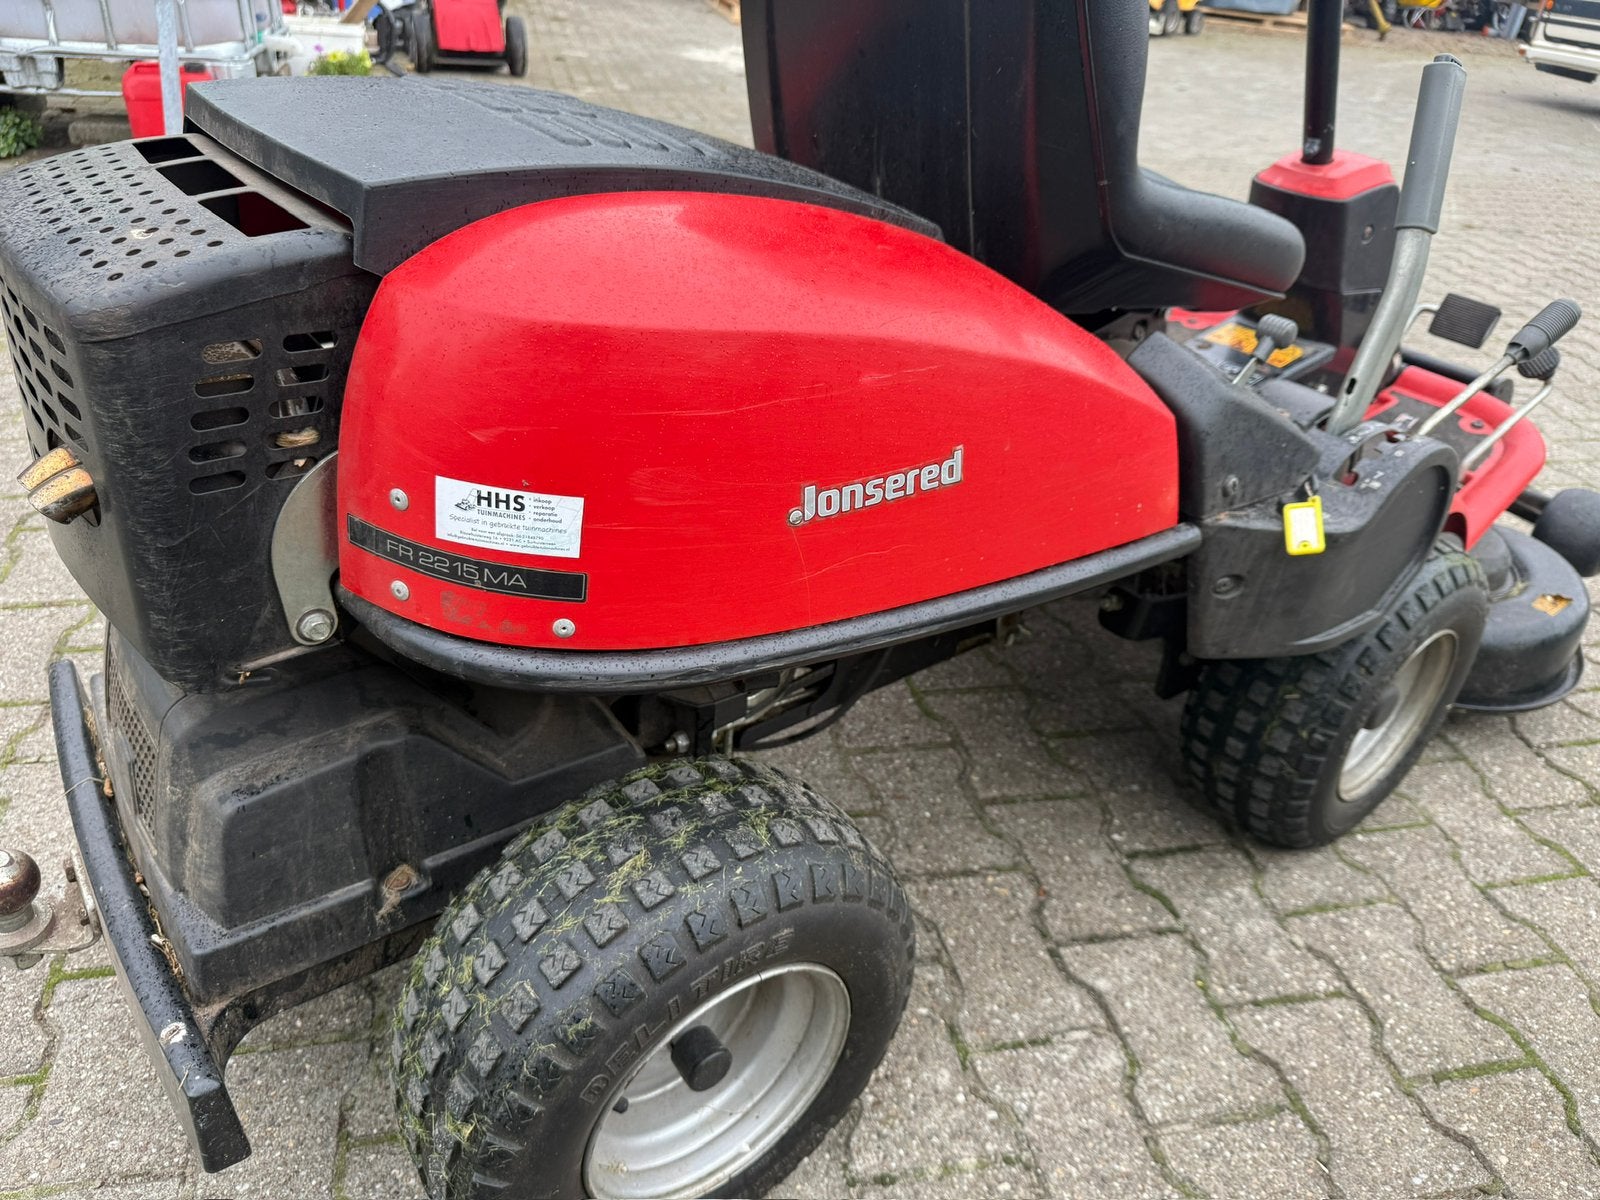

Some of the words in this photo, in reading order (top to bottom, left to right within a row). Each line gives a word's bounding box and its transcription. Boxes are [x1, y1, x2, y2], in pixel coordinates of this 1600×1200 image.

[476, 489, 526, 512] HHS
[789, 448, 963, 526] Jonsered
[449, 513, 481, 525] Specialist
[481, 518, 488, 526] in
[522, 524, 567, 535] tuinmachines
[477, 508, 526, 521] TUINMACHINES
[386, 540, 414, 561] FR
[418, 551, 479, 580] 2215
[484, 568, 527, 589] MA
[580, 995, 681, 1104] DELI
[690, 928, 794, 999] TIRE
